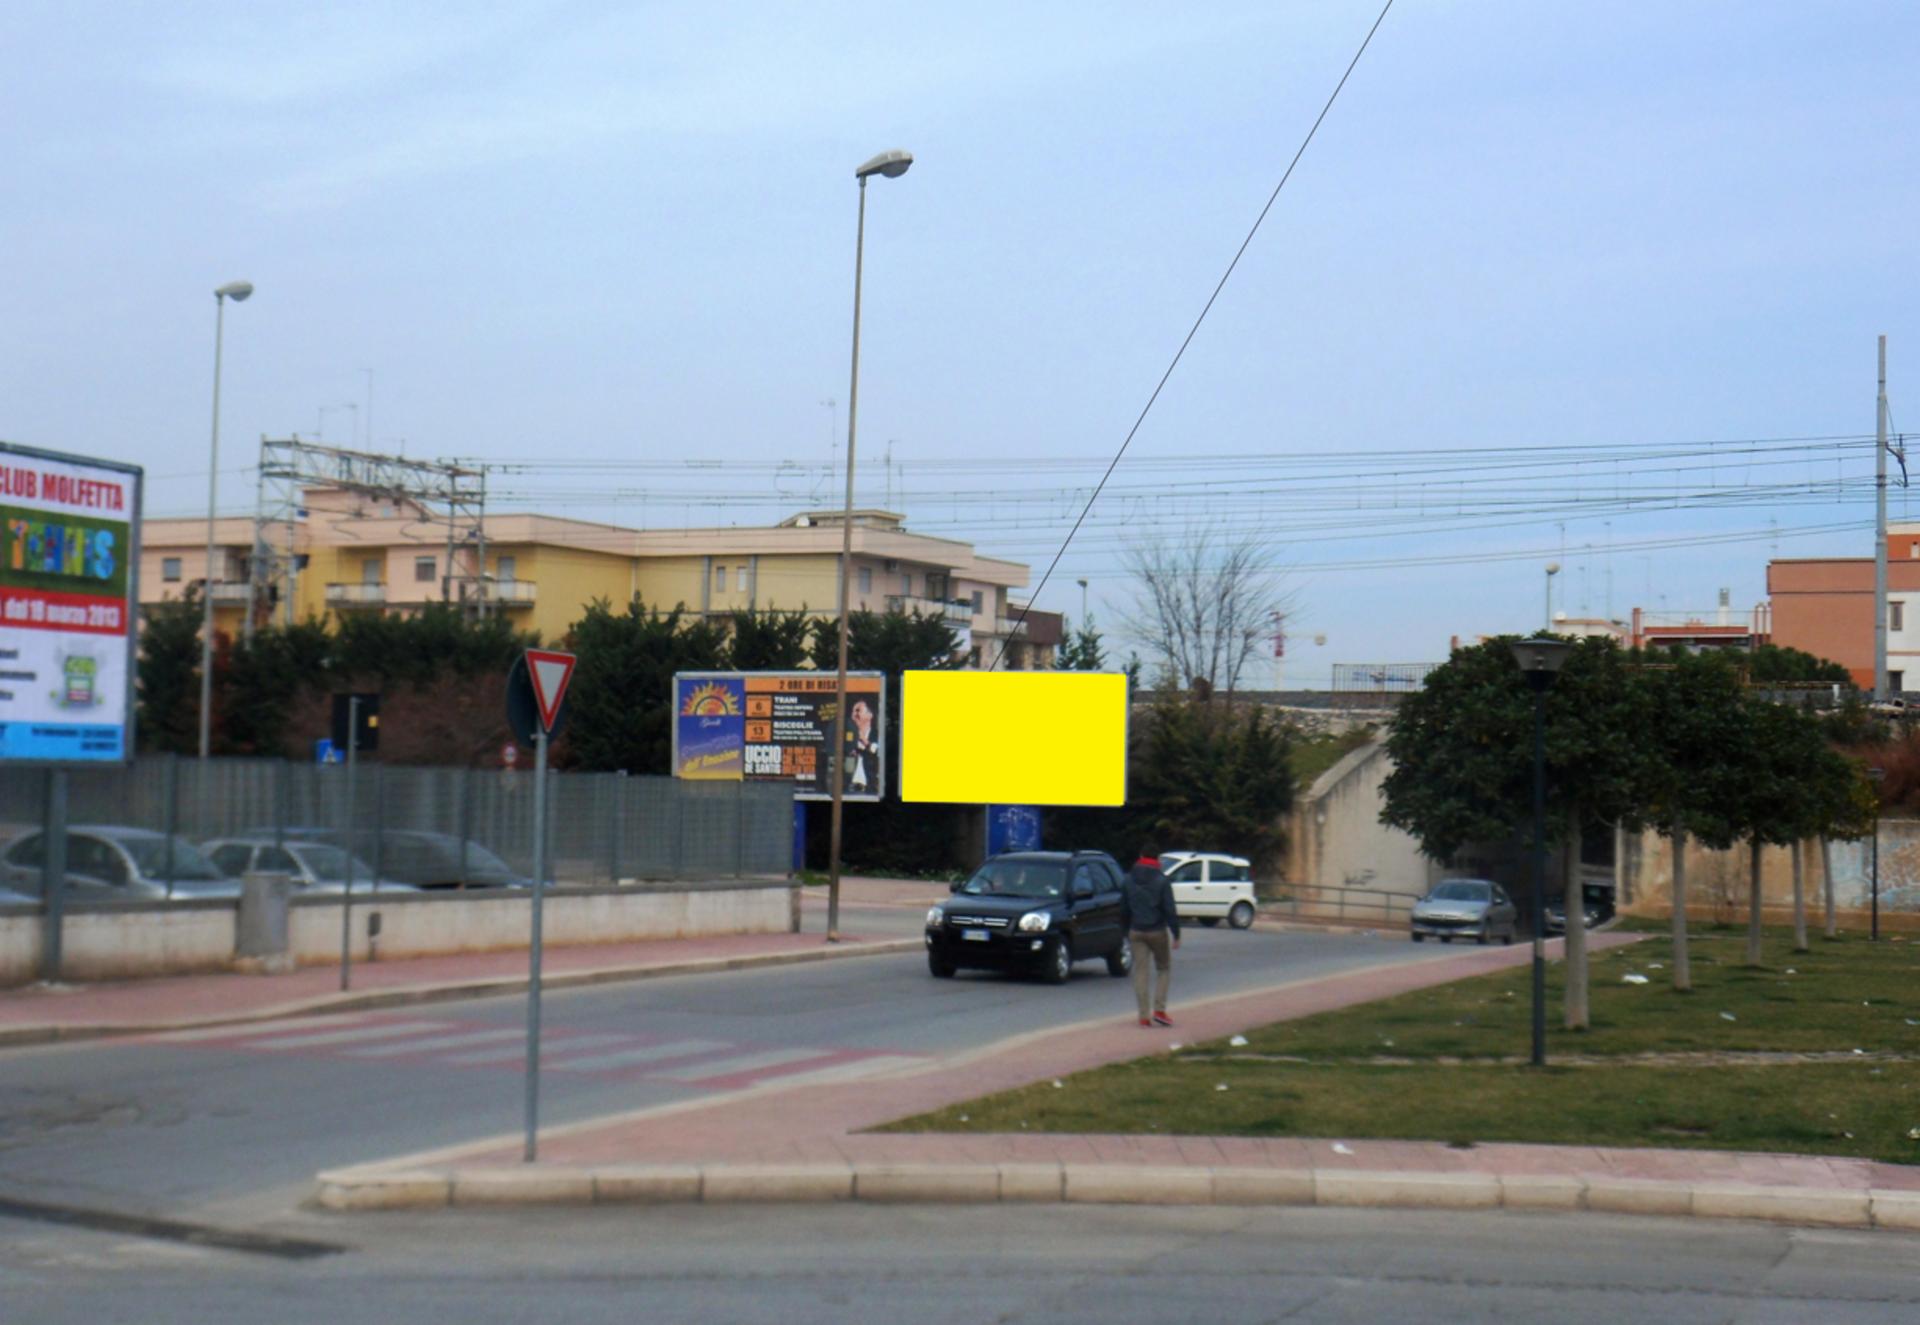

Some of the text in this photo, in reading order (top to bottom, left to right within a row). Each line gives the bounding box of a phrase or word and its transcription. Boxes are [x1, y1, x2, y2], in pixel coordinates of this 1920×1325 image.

[43, 472, 124, 511] MOLFETTA
[8, 519, 115, 579] TENNIS
[5, 597, 28, 620] dal
[779, 680, 785, 690] 2
[787, 680, 802, 690] ORE
[806, 680, 815, 690] DI
[755, 702, 762, 711] 6
[774, 696, 798, 704] TRANI
[753, 726, 764, 736] 13
[745, 744, 781, 763] UCCIO
